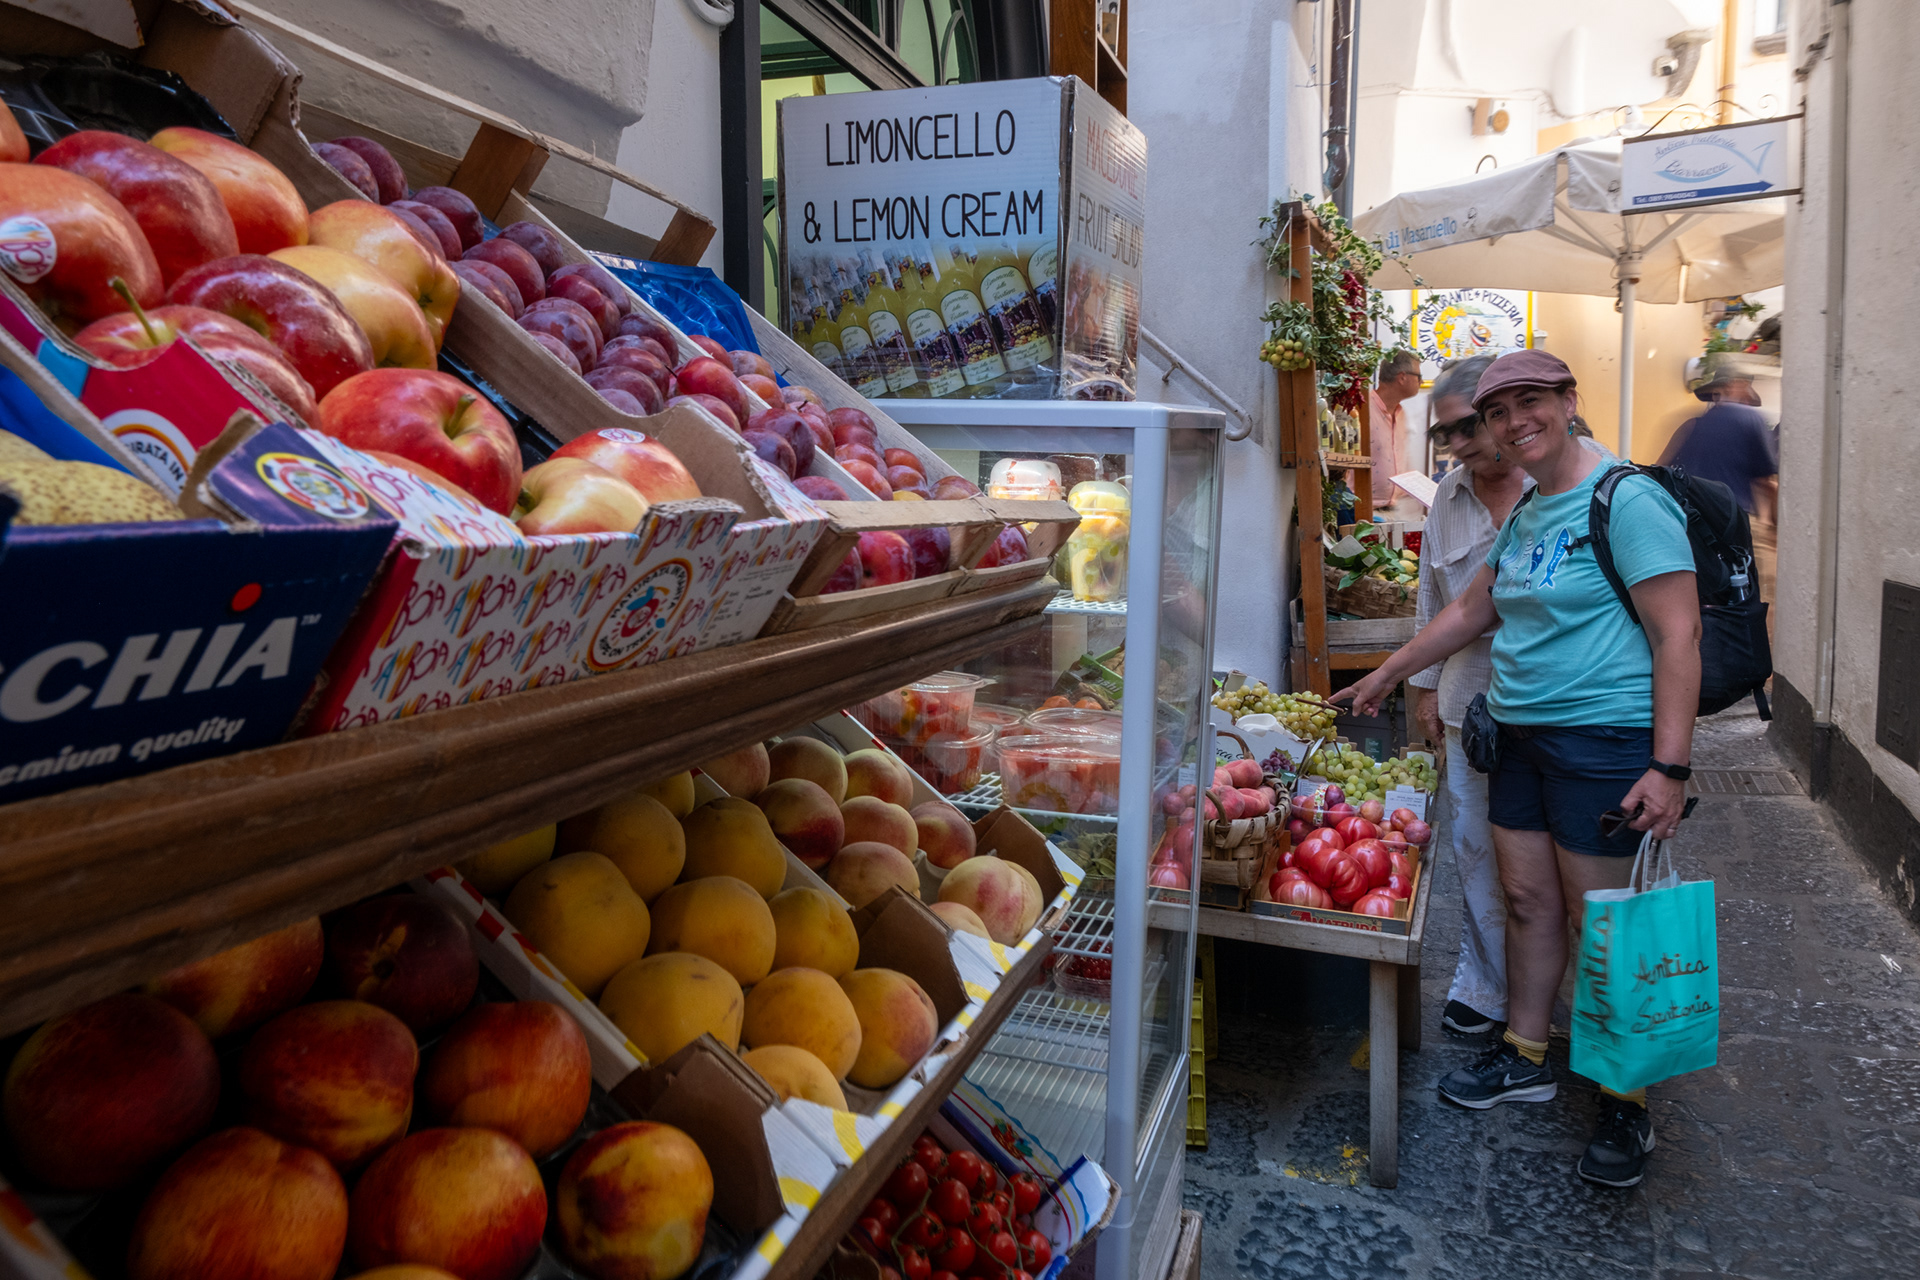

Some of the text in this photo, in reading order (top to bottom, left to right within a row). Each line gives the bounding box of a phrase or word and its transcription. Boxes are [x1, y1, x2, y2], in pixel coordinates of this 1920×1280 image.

[825, 109, 1015, 166] LIMONCELLO
[804, 189, 1043, 243] & LEMON CREAM
[1077, 192, 1141, 269] FRUIT SALAD
[1386, 230, 1400, 250] di
[1482, 290, 1524, 328] PIZZERIA
[168, 461, 184, 481] IN
[0, 616, 298, 723] CHIA
[129, 716, 246, 762] quality
[1631, 952, 1709, 993] Antica
